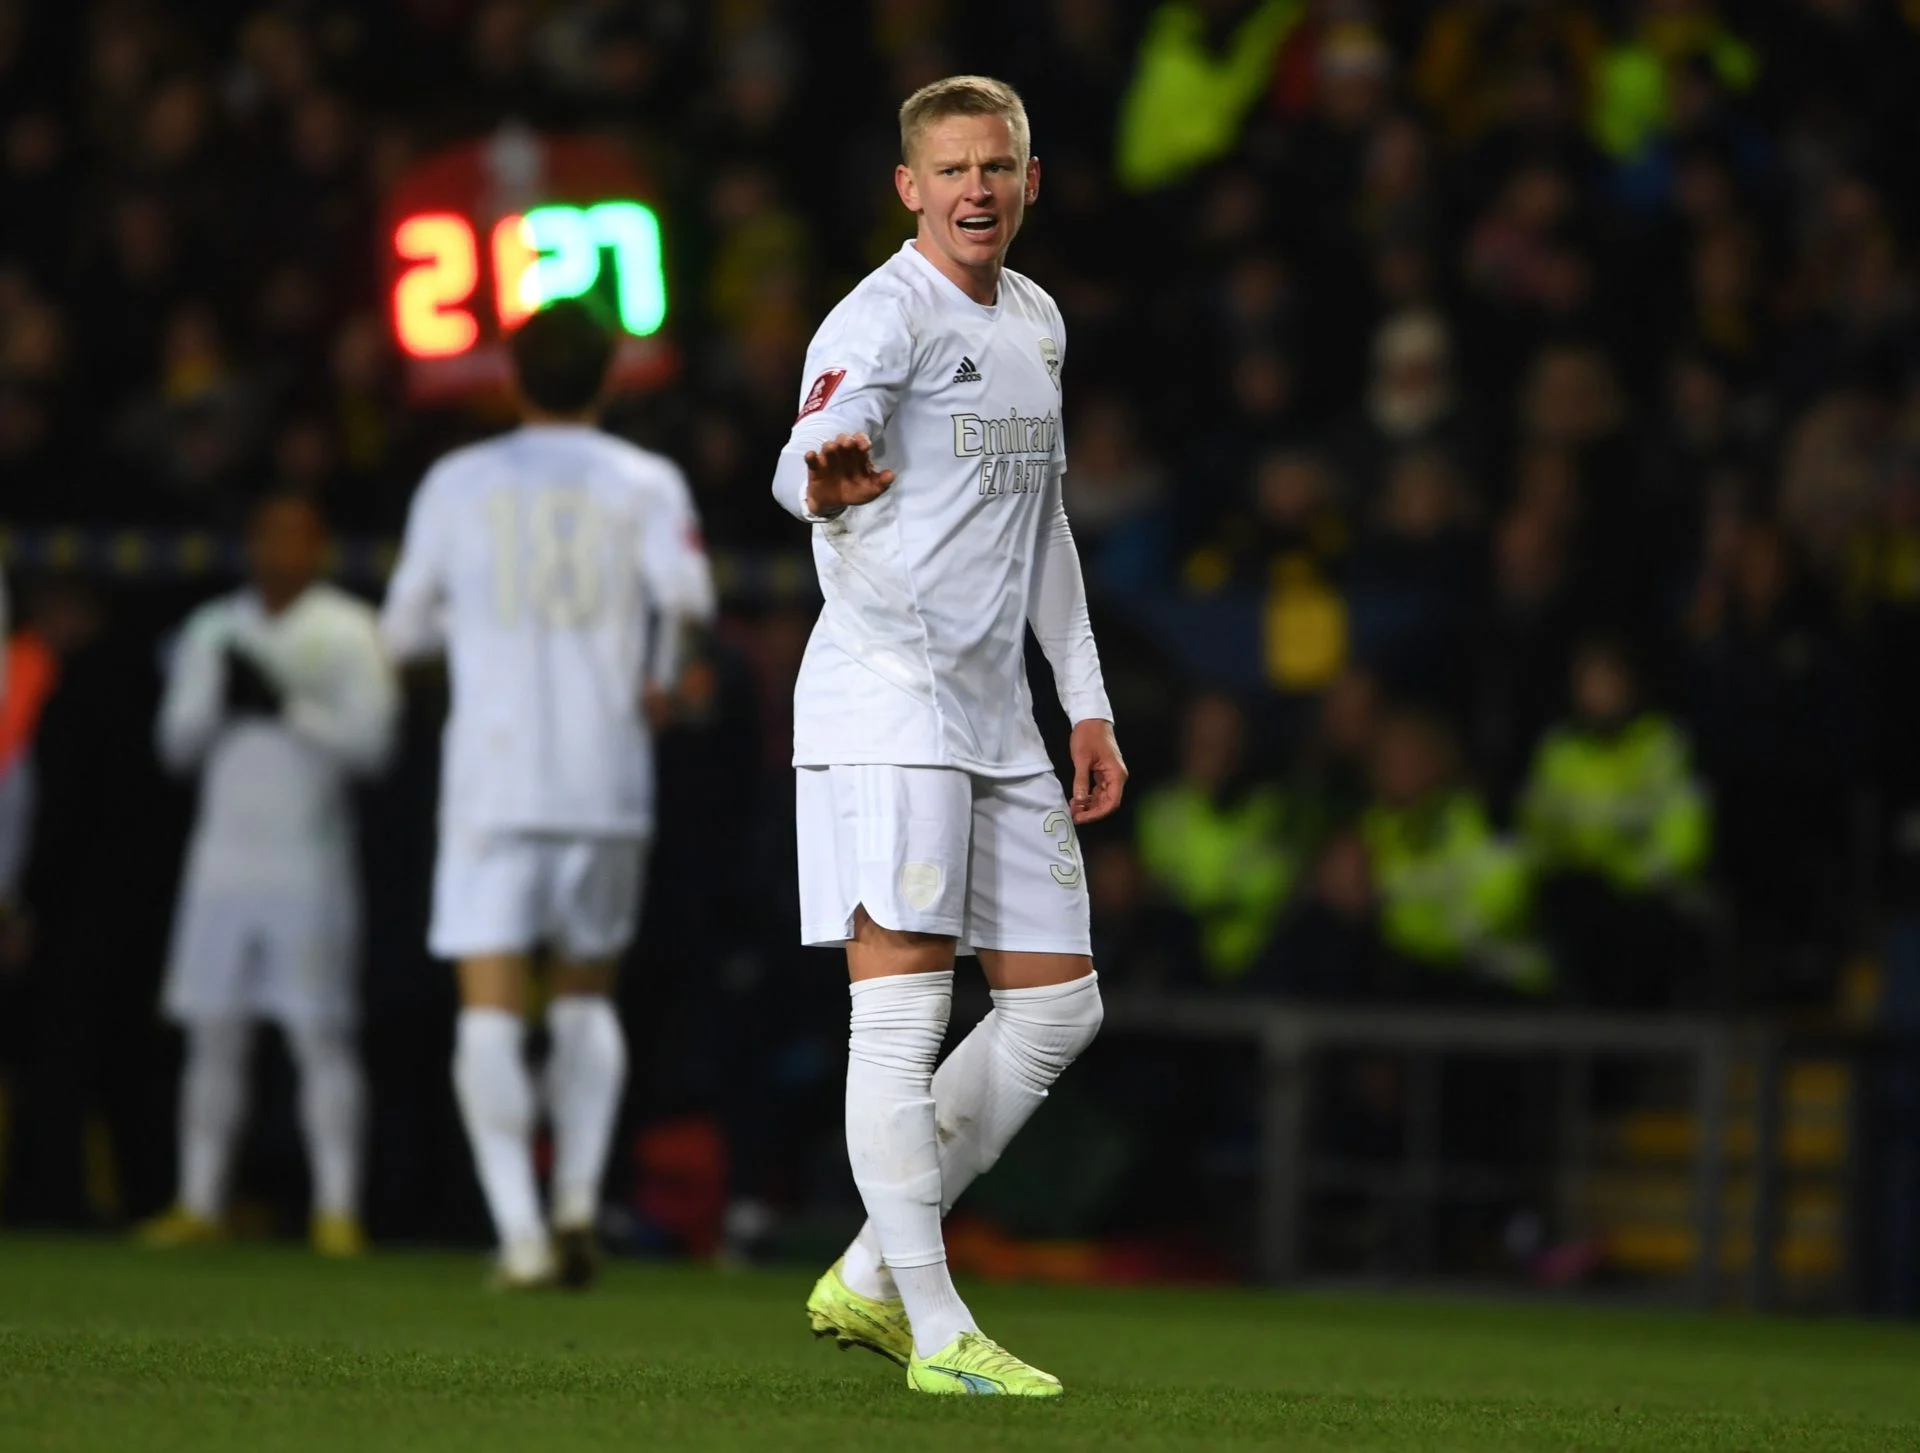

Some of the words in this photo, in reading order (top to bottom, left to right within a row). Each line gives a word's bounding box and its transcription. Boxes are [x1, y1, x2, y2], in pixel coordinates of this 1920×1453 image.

[953, 372, 982, 384] adidas
[979, 460, 1010, 495] FLY
[487, 487, 603, 628] 18
